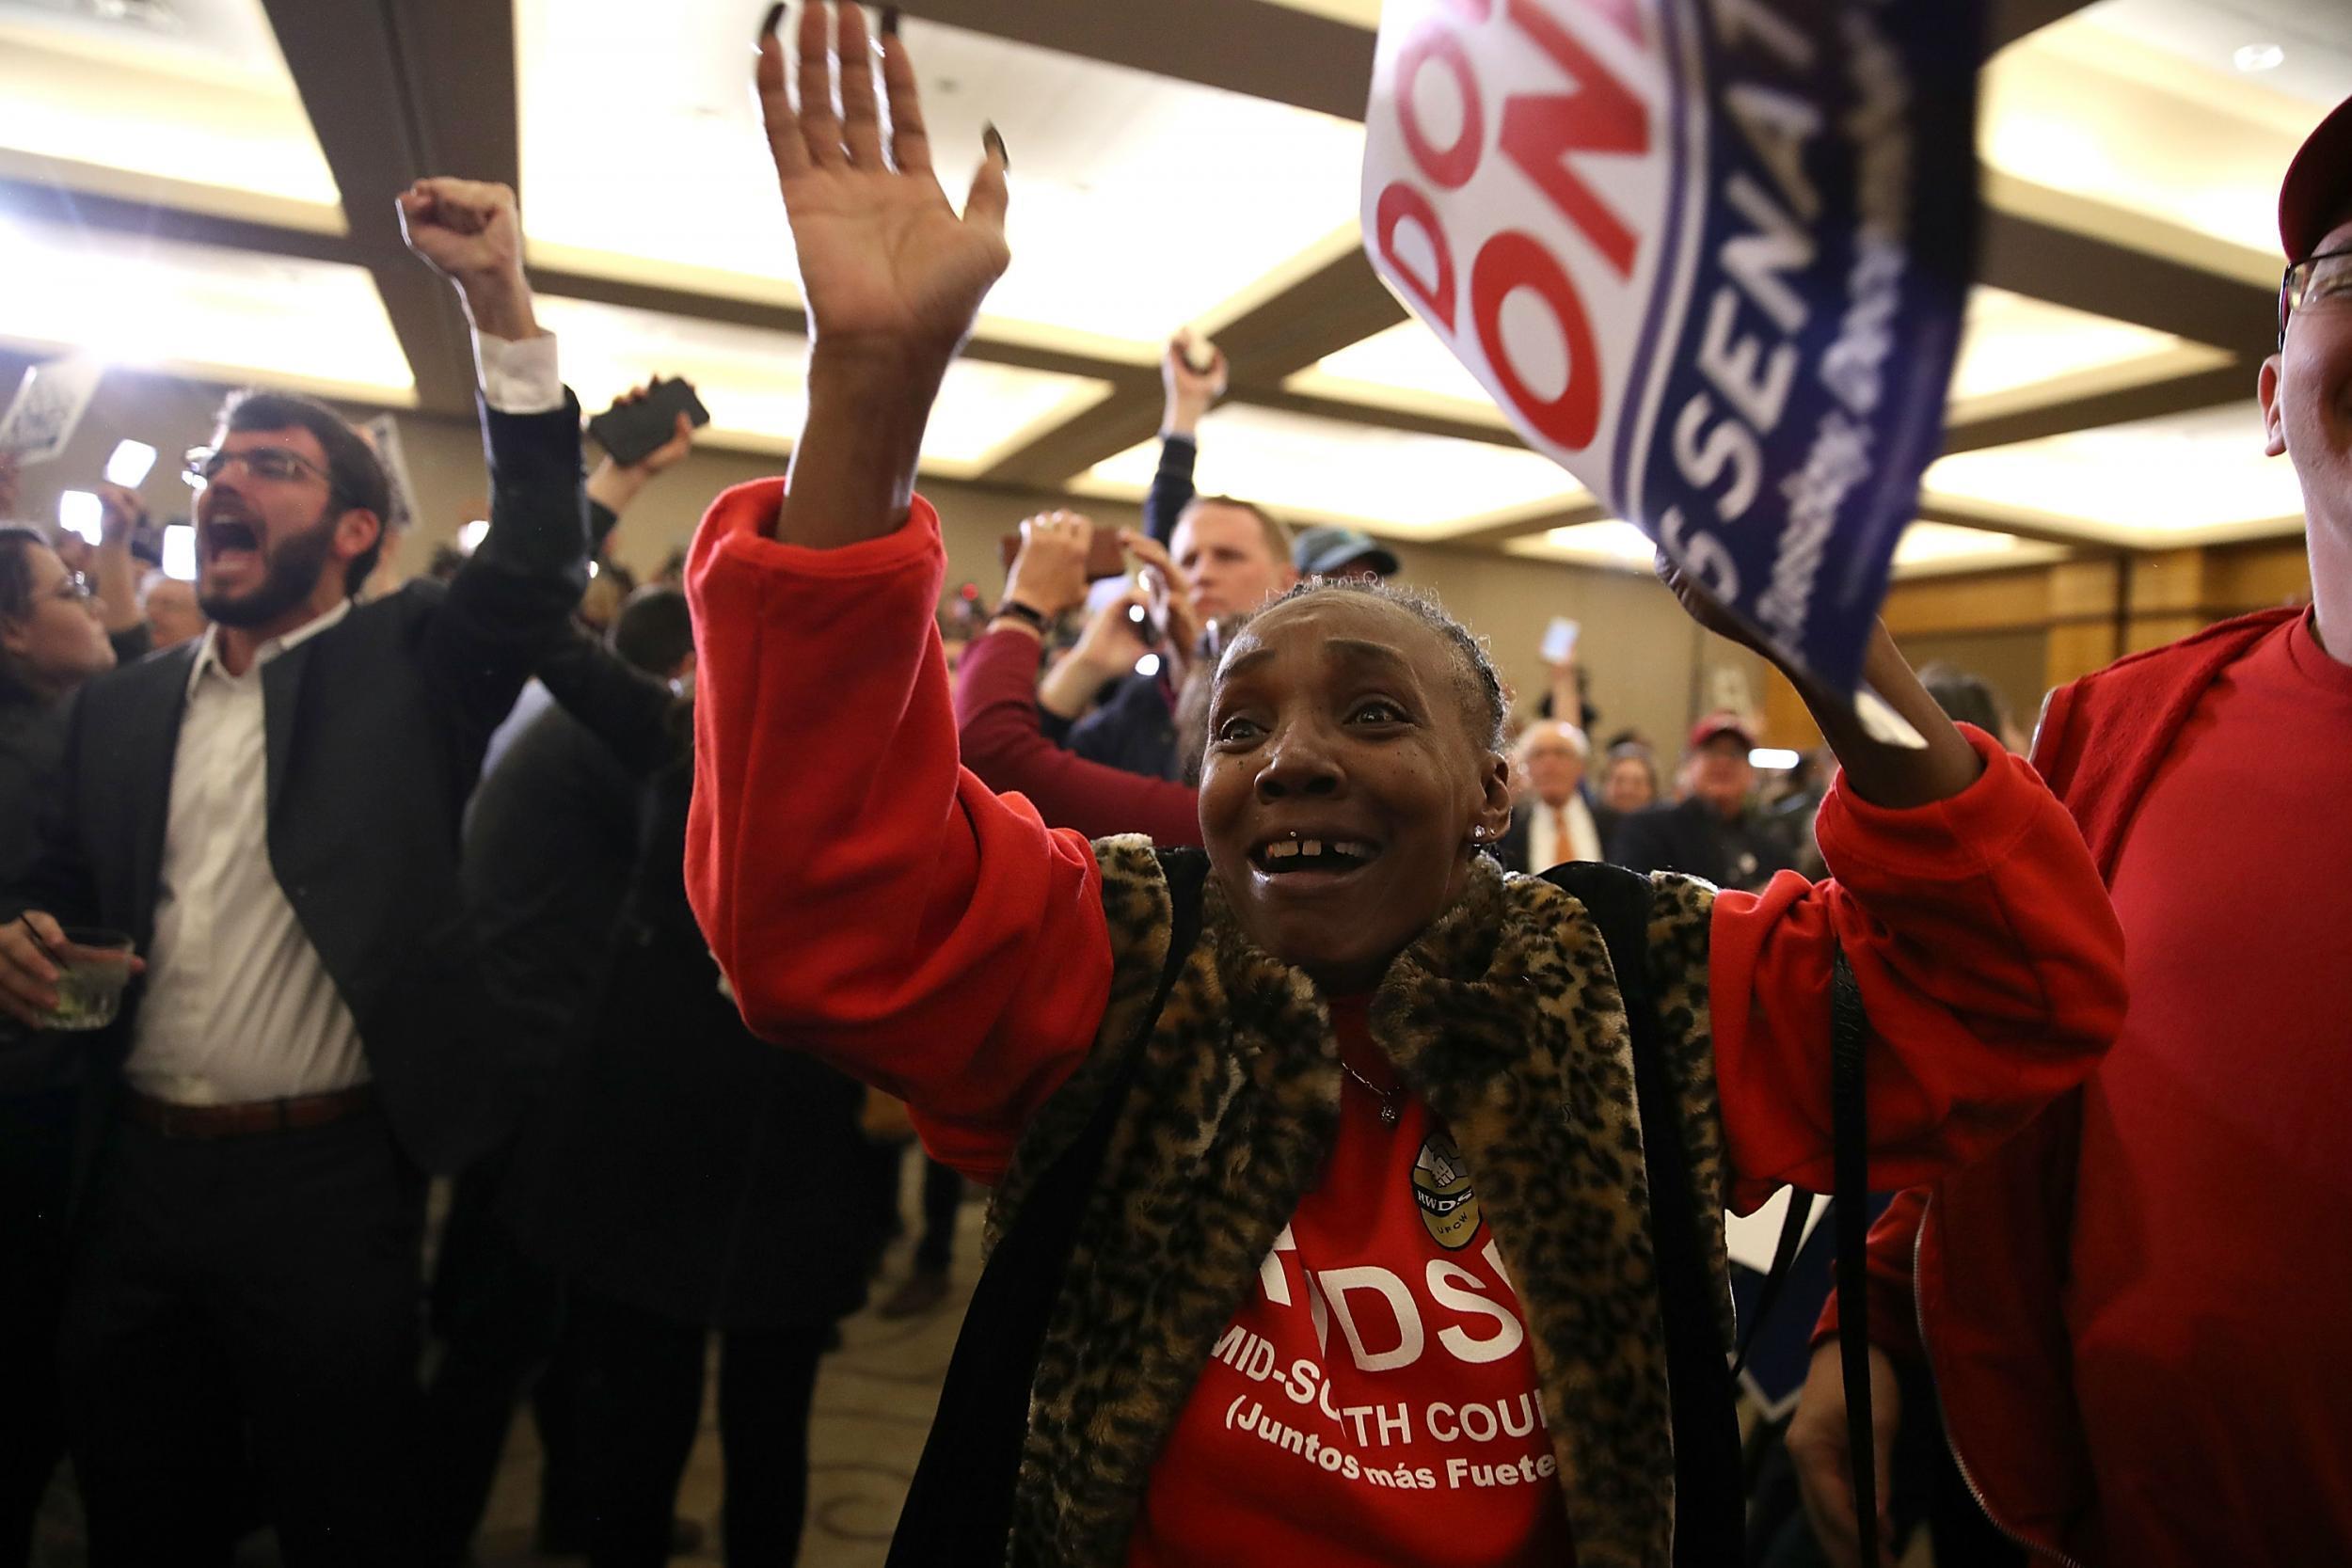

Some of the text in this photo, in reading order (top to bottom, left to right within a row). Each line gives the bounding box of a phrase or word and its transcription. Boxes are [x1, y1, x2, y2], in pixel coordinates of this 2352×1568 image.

[1376, 0, 1492, 339] DO
[1471, 0, 1651, 453] ON
[1226, 1395, 1360, 1481] (Juntos
[1363, 1463, 1437, 1490] más
